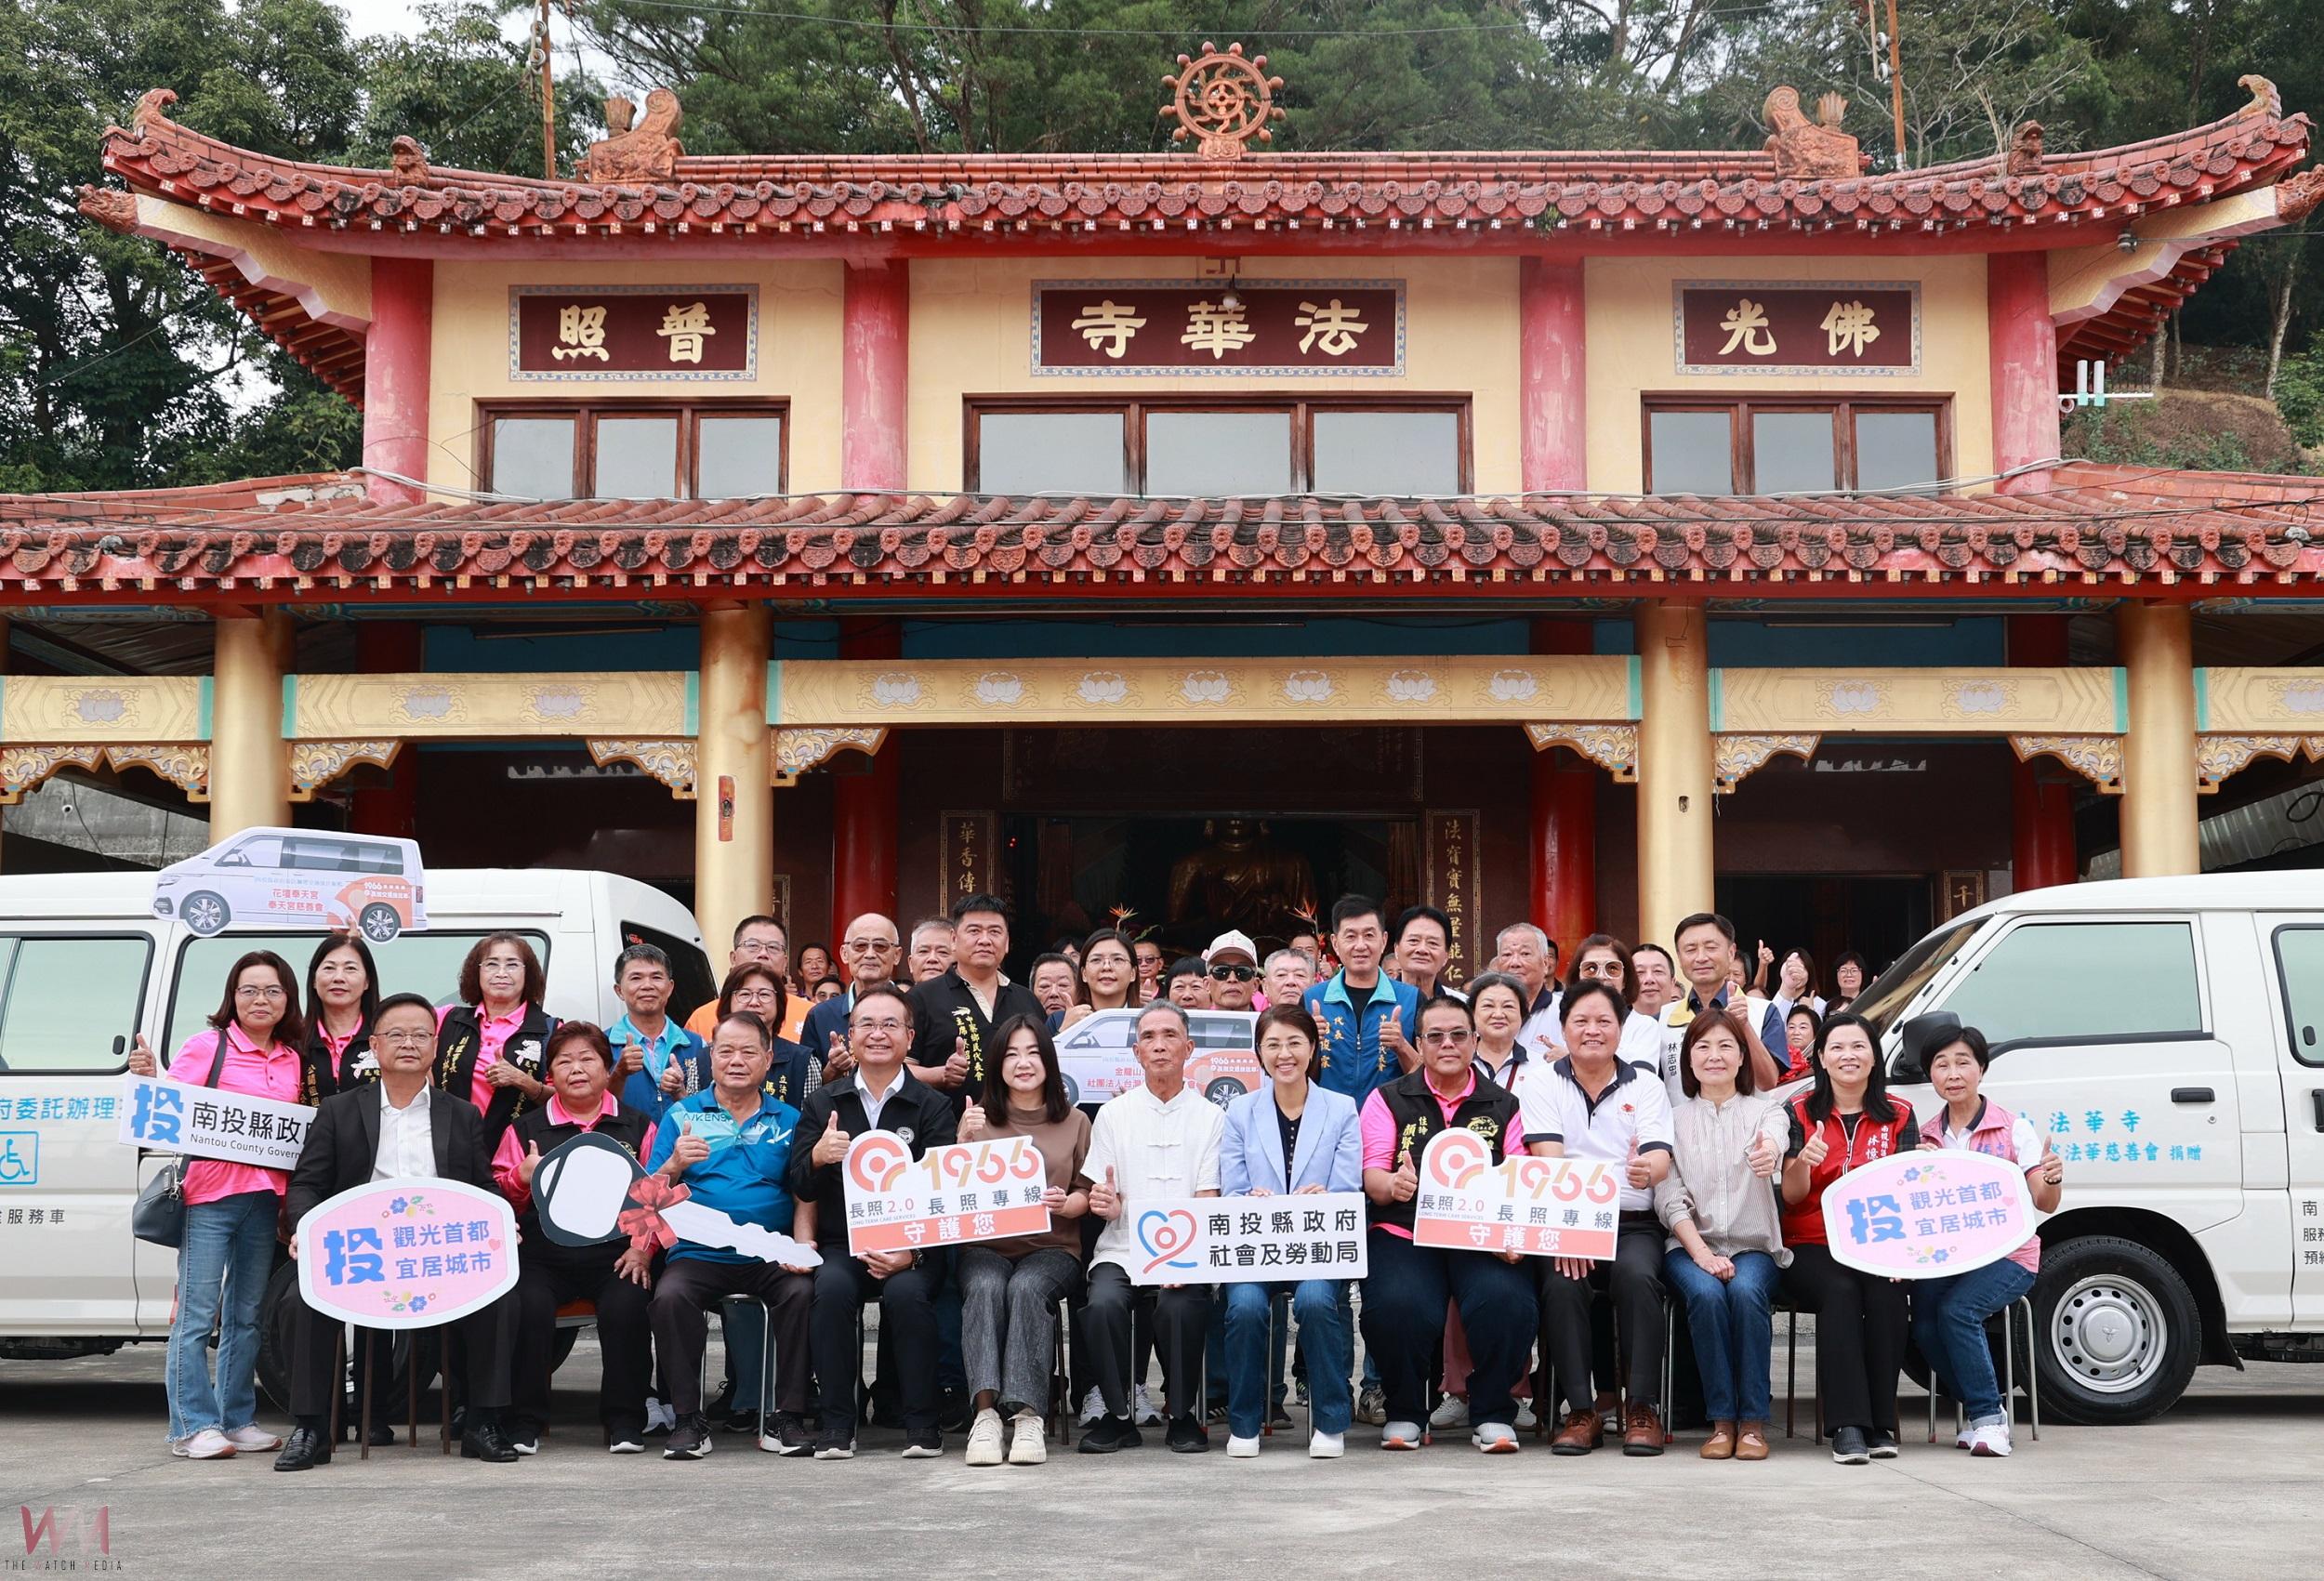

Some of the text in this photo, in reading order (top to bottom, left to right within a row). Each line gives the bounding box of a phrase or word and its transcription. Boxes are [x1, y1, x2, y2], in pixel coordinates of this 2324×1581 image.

[1087, 1078, 1144, 1088] 社團法人台灣
[0, 1096, 124, 1121] 府委託辦理
[130, 1084, 184, 1145] 投
[2020, 1110, 2141, 1134] 法華寺
[191, 1134, 227, 1148] Nantou
[230, 1139, 264, 1155] County
[2170, 1144, 2202, 1161] 捐贈
[921, 1140, 1039, 1191] 1966
[1499, 1158, 1617, 1205] 1966
[928, 1185, 1043, 1216] 長照專線
[1909, 1181, 2002, 1210] 觀光首都
[2302, 1200, 2317, 1217] 南
[0, 1207, 66, 1225] 服務車
[904, 1212, 996, 1244] 守護您
[1208, 1209, 1357, 1236] 南投縣政府
[1497, 1205, 1613, 1229] 長照專線
[1846, 1193, 1907, 1245] 投
[1915, 1207, 2008, 1237] 宜居城市
[393, 1220, 490, 1248] 觀光首都
[1469, 1224, 1561, 1251] 守護您
[323, 1227, 386, 1286] 投
[395, 1251, 492, 1280] 宜居城市
[1209, 1241, 1359, 1268] 社會及勞動局
